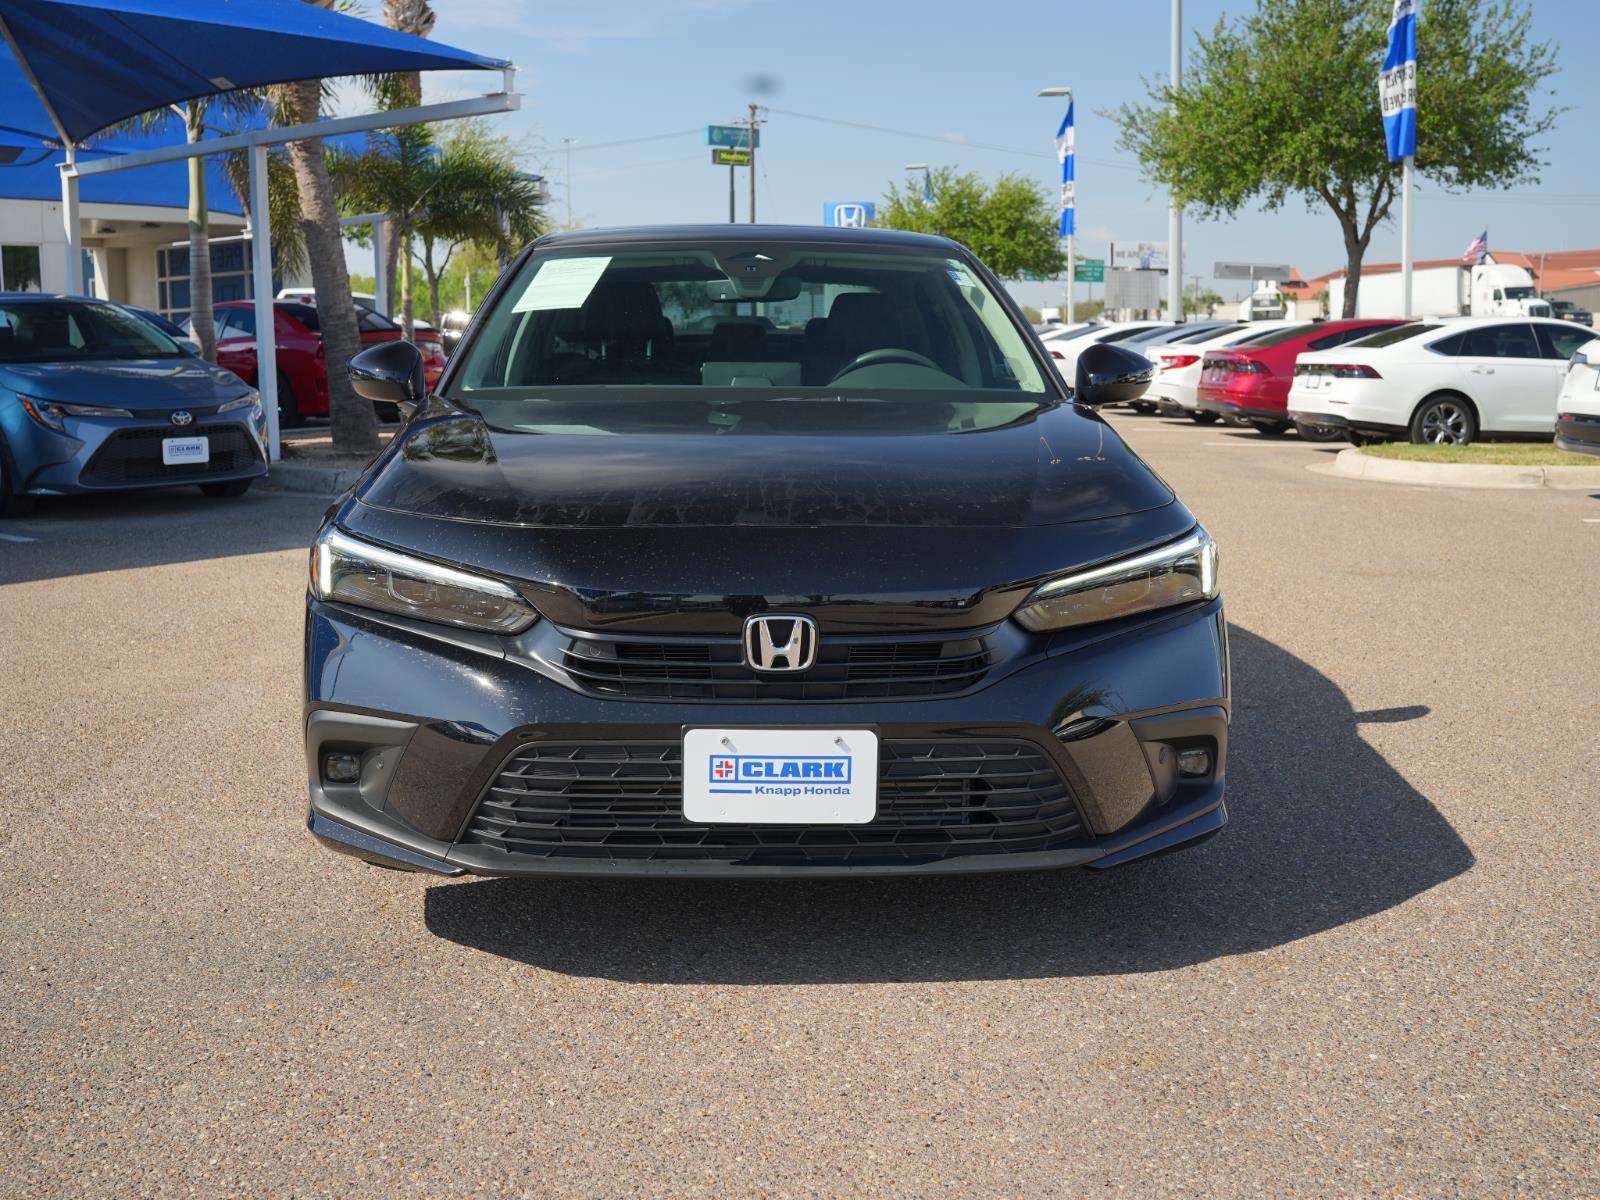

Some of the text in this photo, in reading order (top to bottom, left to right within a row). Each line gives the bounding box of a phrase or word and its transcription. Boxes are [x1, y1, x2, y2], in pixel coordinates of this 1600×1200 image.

[742, 762, 845, 777] CLARK
[755, 786, 850, 797] Knapp Honda
